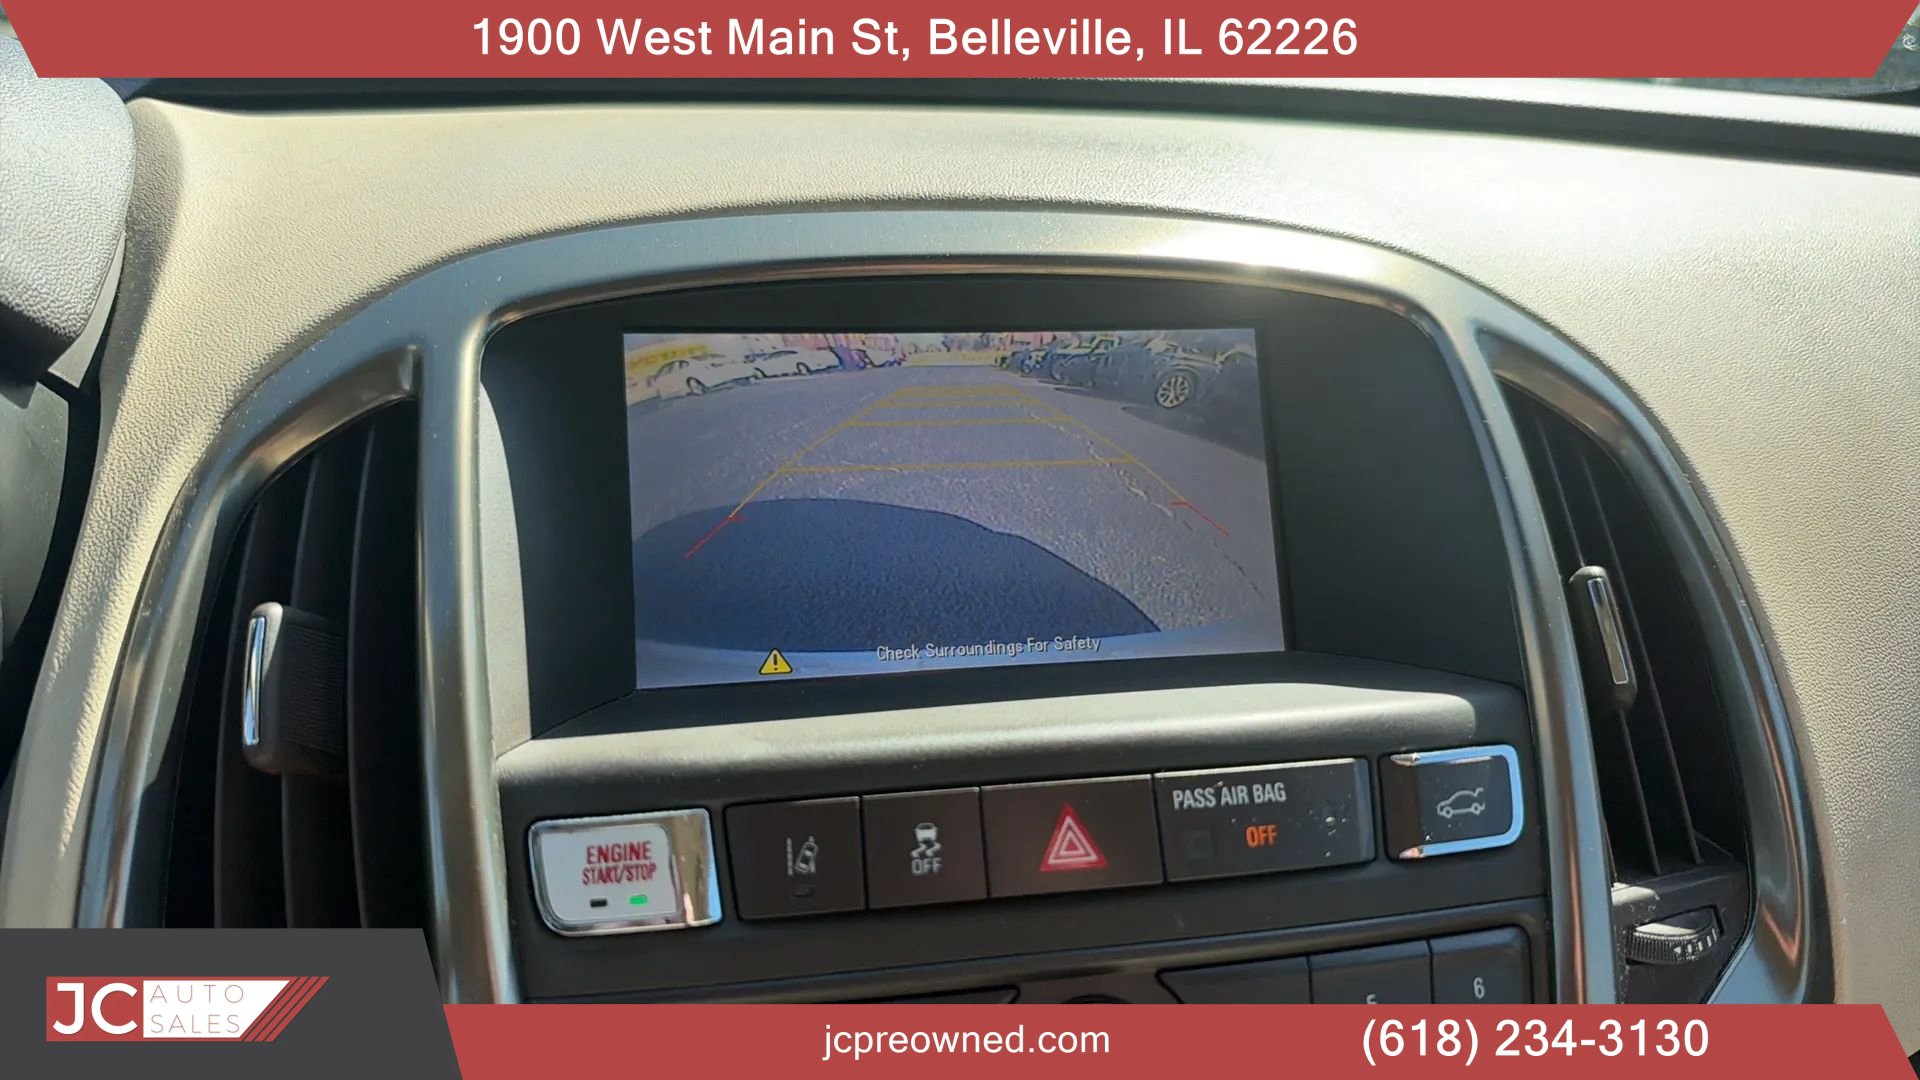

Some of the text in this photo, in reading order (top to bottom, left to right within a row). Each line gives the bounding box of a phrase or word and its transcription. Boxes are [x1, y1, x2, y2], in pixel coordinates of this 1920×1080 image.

[876, 635, 1101, 661] Check Surroundings For Safety
[1172, 782, 1287, 810] PASS AIR BAG
[1245, 824, 1278, 848] OFF
[586, 840, 653, 865] ENGINE
[582, 862, 656, 885] START/STOP
[911, 857, 943, 876] OFF
[1473, 976, 1486, 1000] 6
